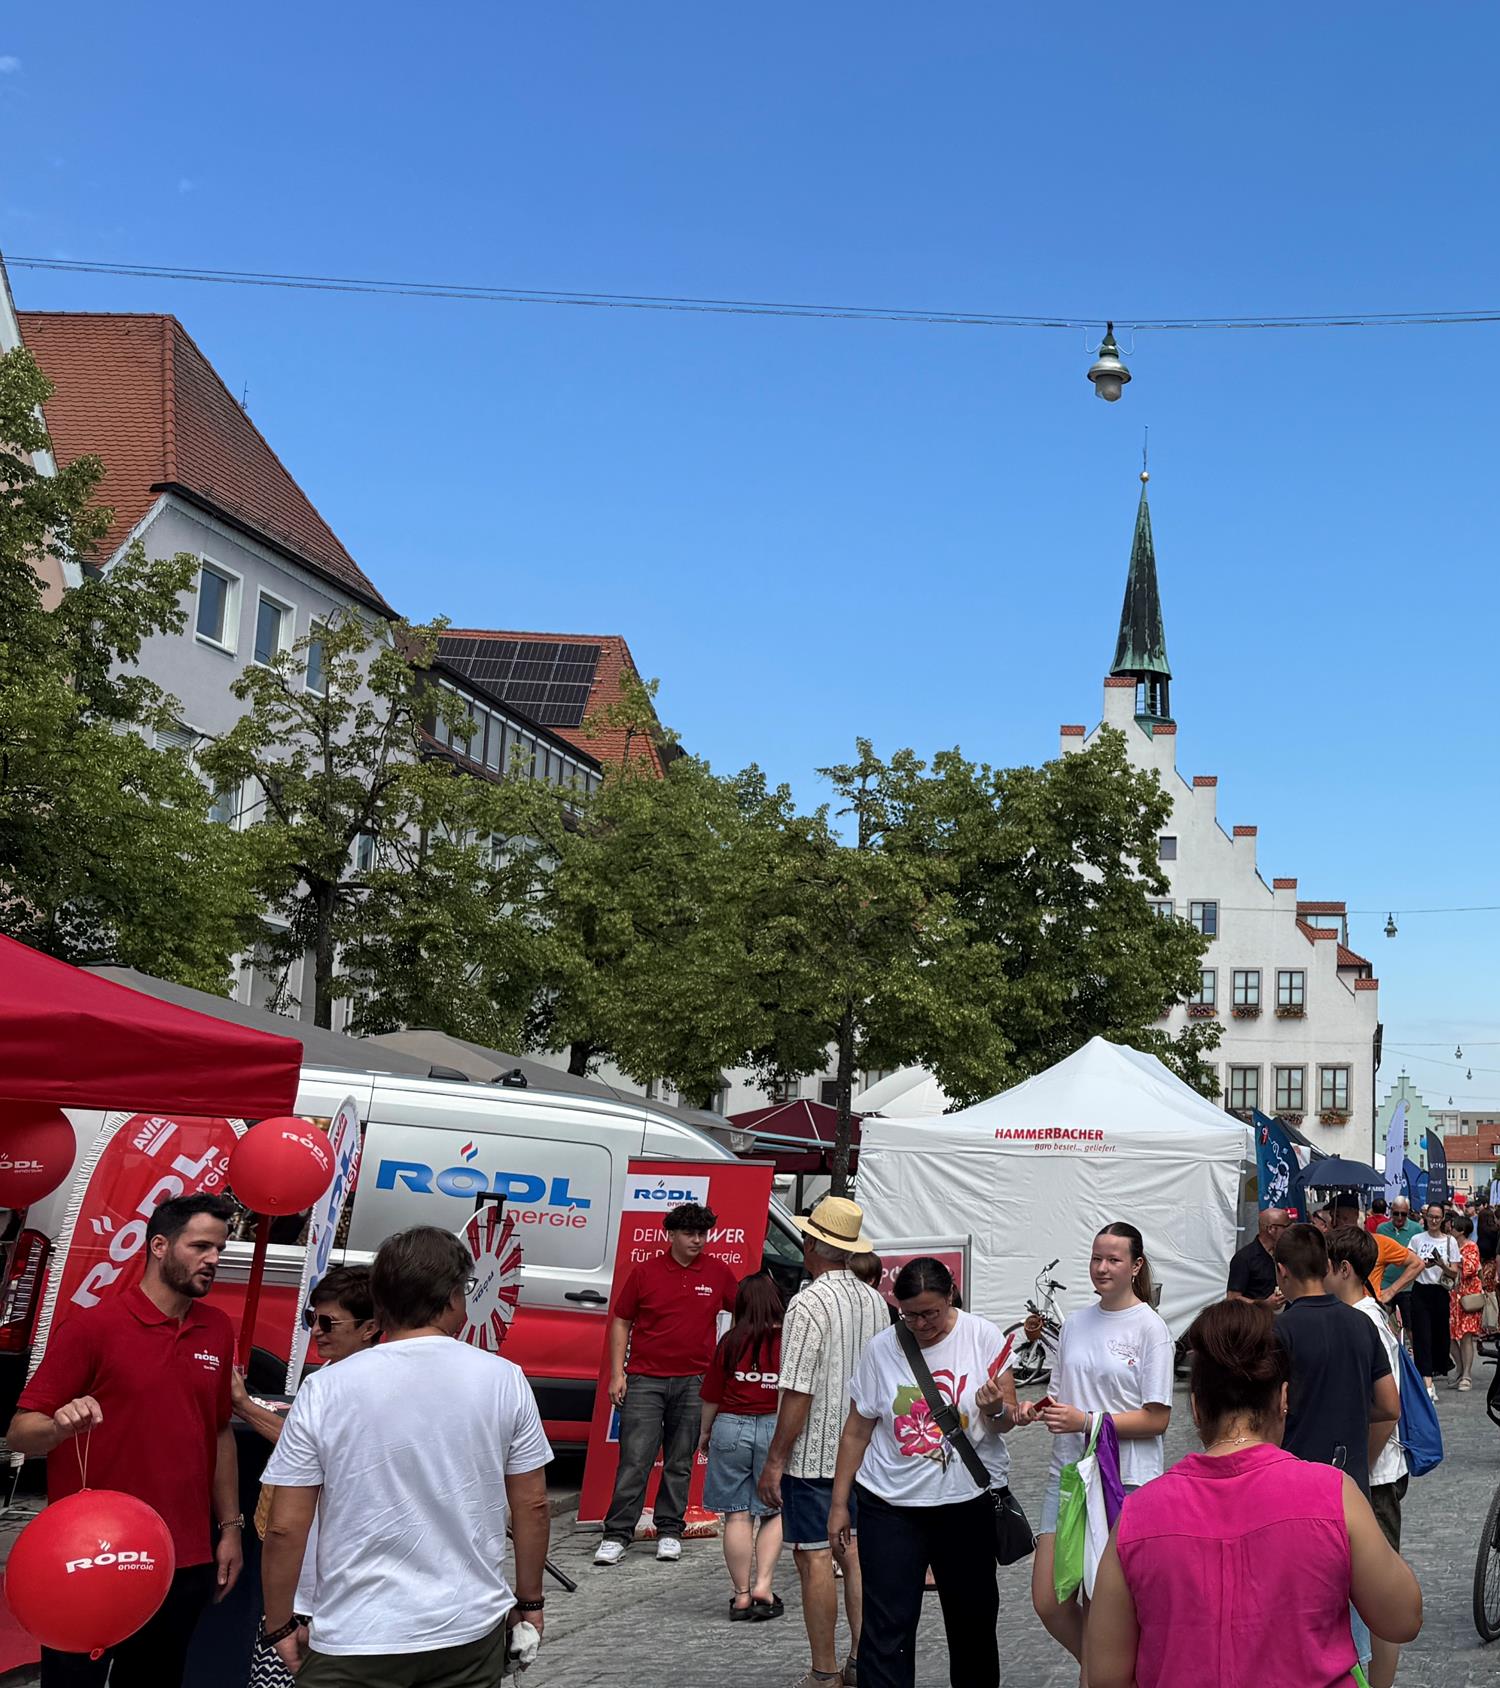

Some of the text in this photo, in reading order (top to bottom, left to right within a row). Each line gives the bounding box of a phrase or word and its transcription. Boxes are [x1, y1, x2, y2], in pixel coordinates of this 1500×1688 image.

[132, 1116, 167, 1151] AVIA
[994, 1127, 1105, 1141] HAMMERBACHER
[0, 1152, 45, 1170] ÖDL
[281, 1131, 329, 1170] RÖDL
[195, 1155, 231, 1195] rgie
[376, 1141, 592, 1210] RÖDL
[633, 1180, 699, 1201] RÖDL
[506, 1203, 588, 1229] nergie
[633, 1228, 745, 1244] DEIN WER
[630, 1248, 652, 1263] für
[65, 1539, 155, 1574] RÖDL
